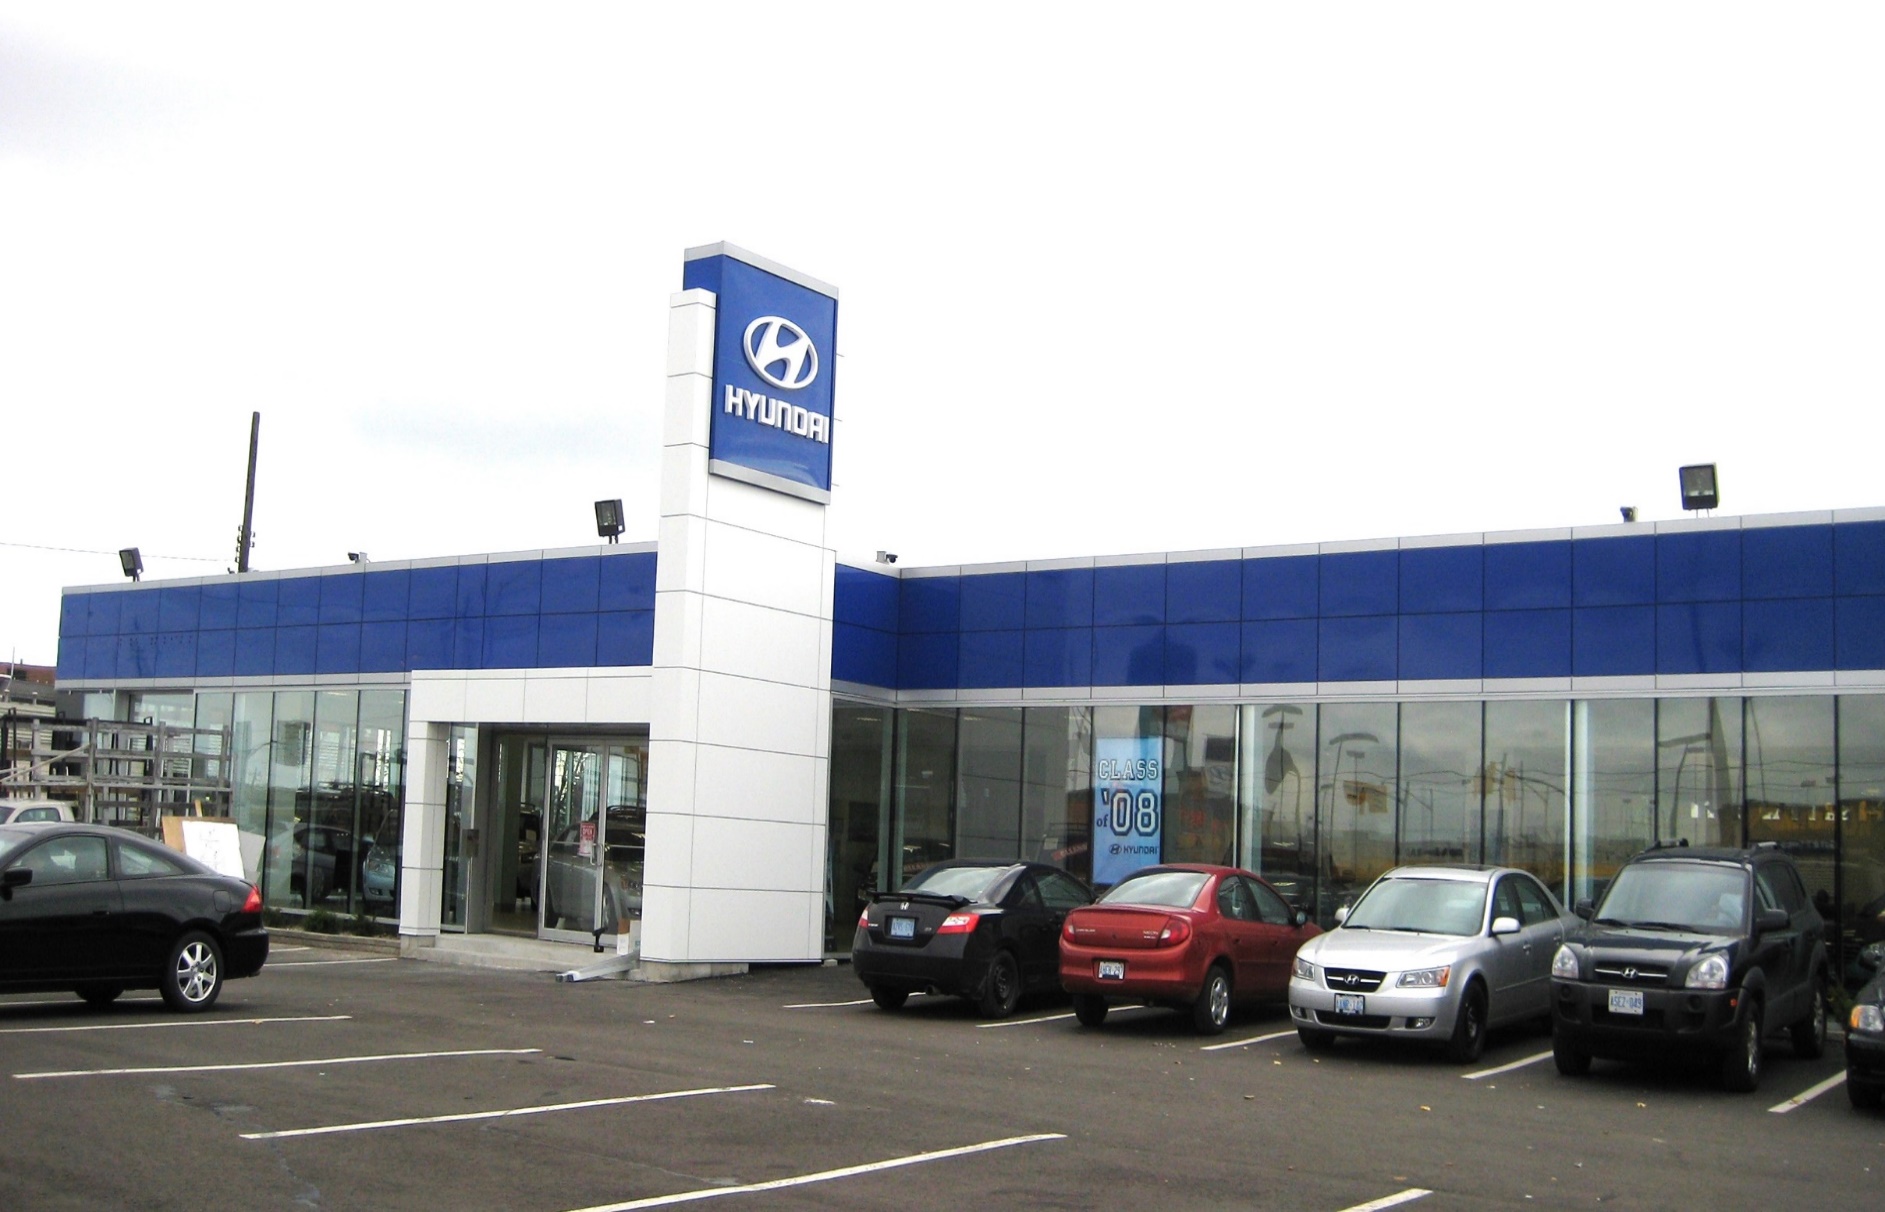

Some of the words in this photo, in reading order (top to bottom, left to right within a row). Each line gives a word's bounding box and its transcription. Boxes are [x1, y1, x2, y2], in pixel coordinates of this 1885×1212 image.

[724, 384, 830, 444] HYUNDAI
[1098, 758, 1159, 780] CLASS
[1096, 814, 1109, 828] of
[1123, 845, 1158, 855] HYUNDAI
